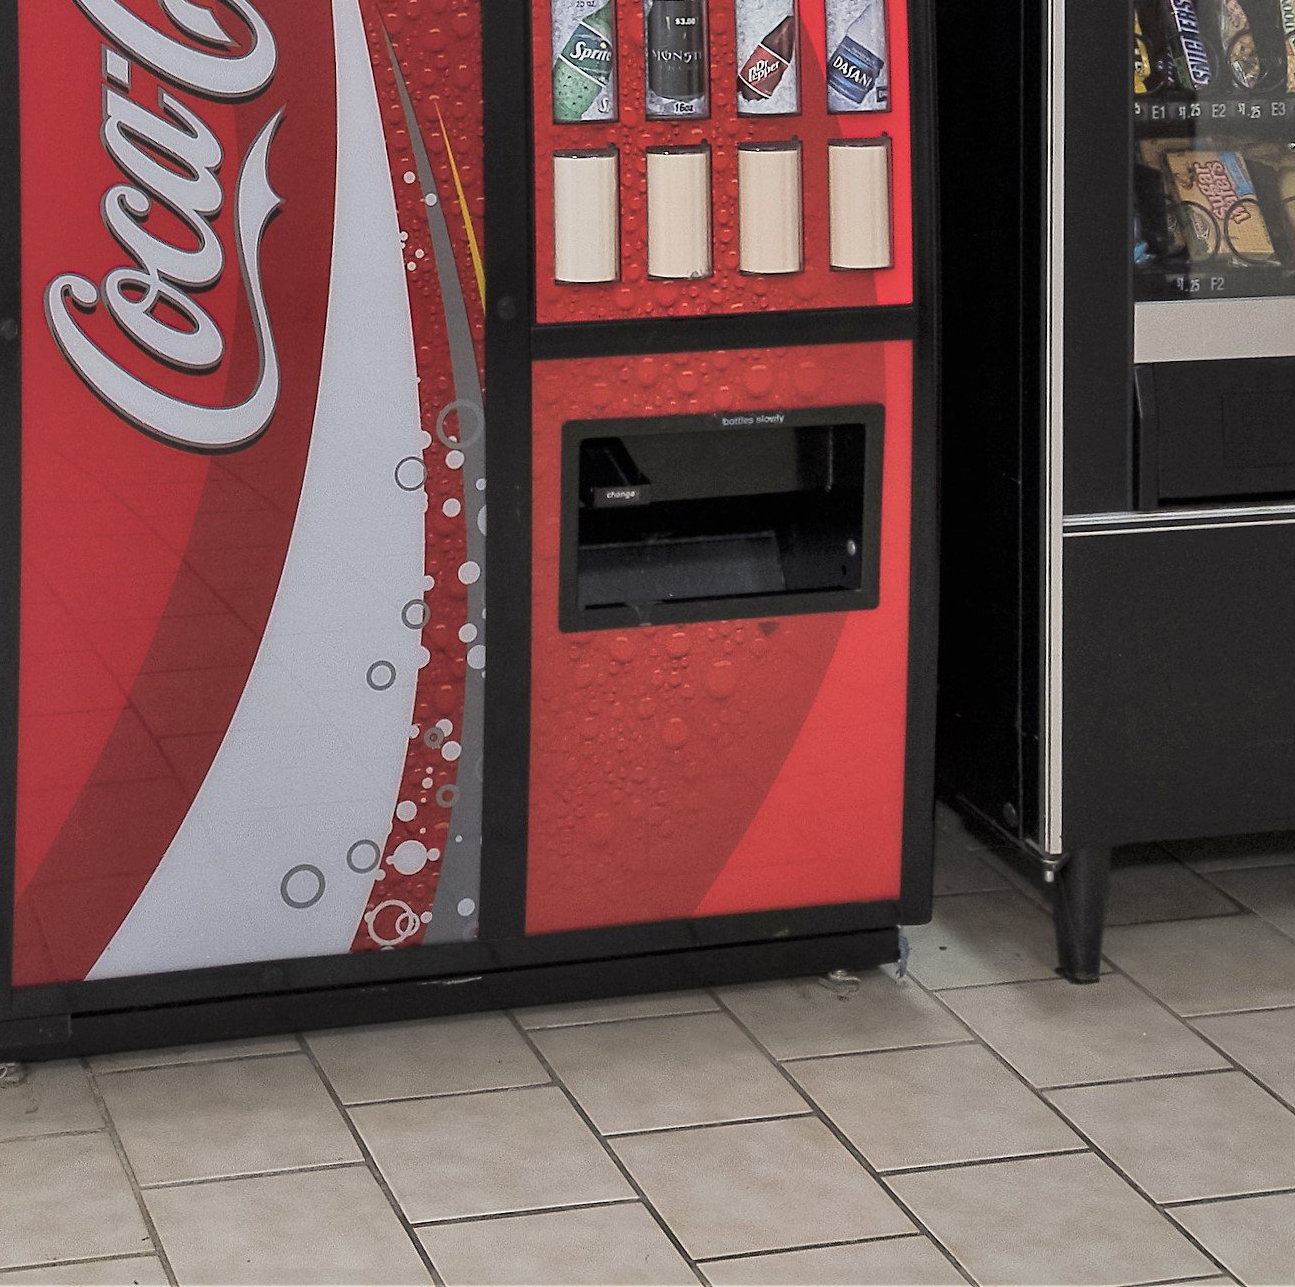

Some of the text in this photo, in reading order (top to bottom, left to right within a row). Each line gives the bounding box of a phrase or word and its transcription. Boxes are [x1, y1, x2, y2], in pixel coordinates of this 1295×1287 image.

[833, 56, 873, 88] DASANI
[1152, 106, 1165, 119] E1
[1212, 104, 1226, 117] E2
[1272, 103, 1285, 115] E3
[1211, 277, 1225, 290] F2
